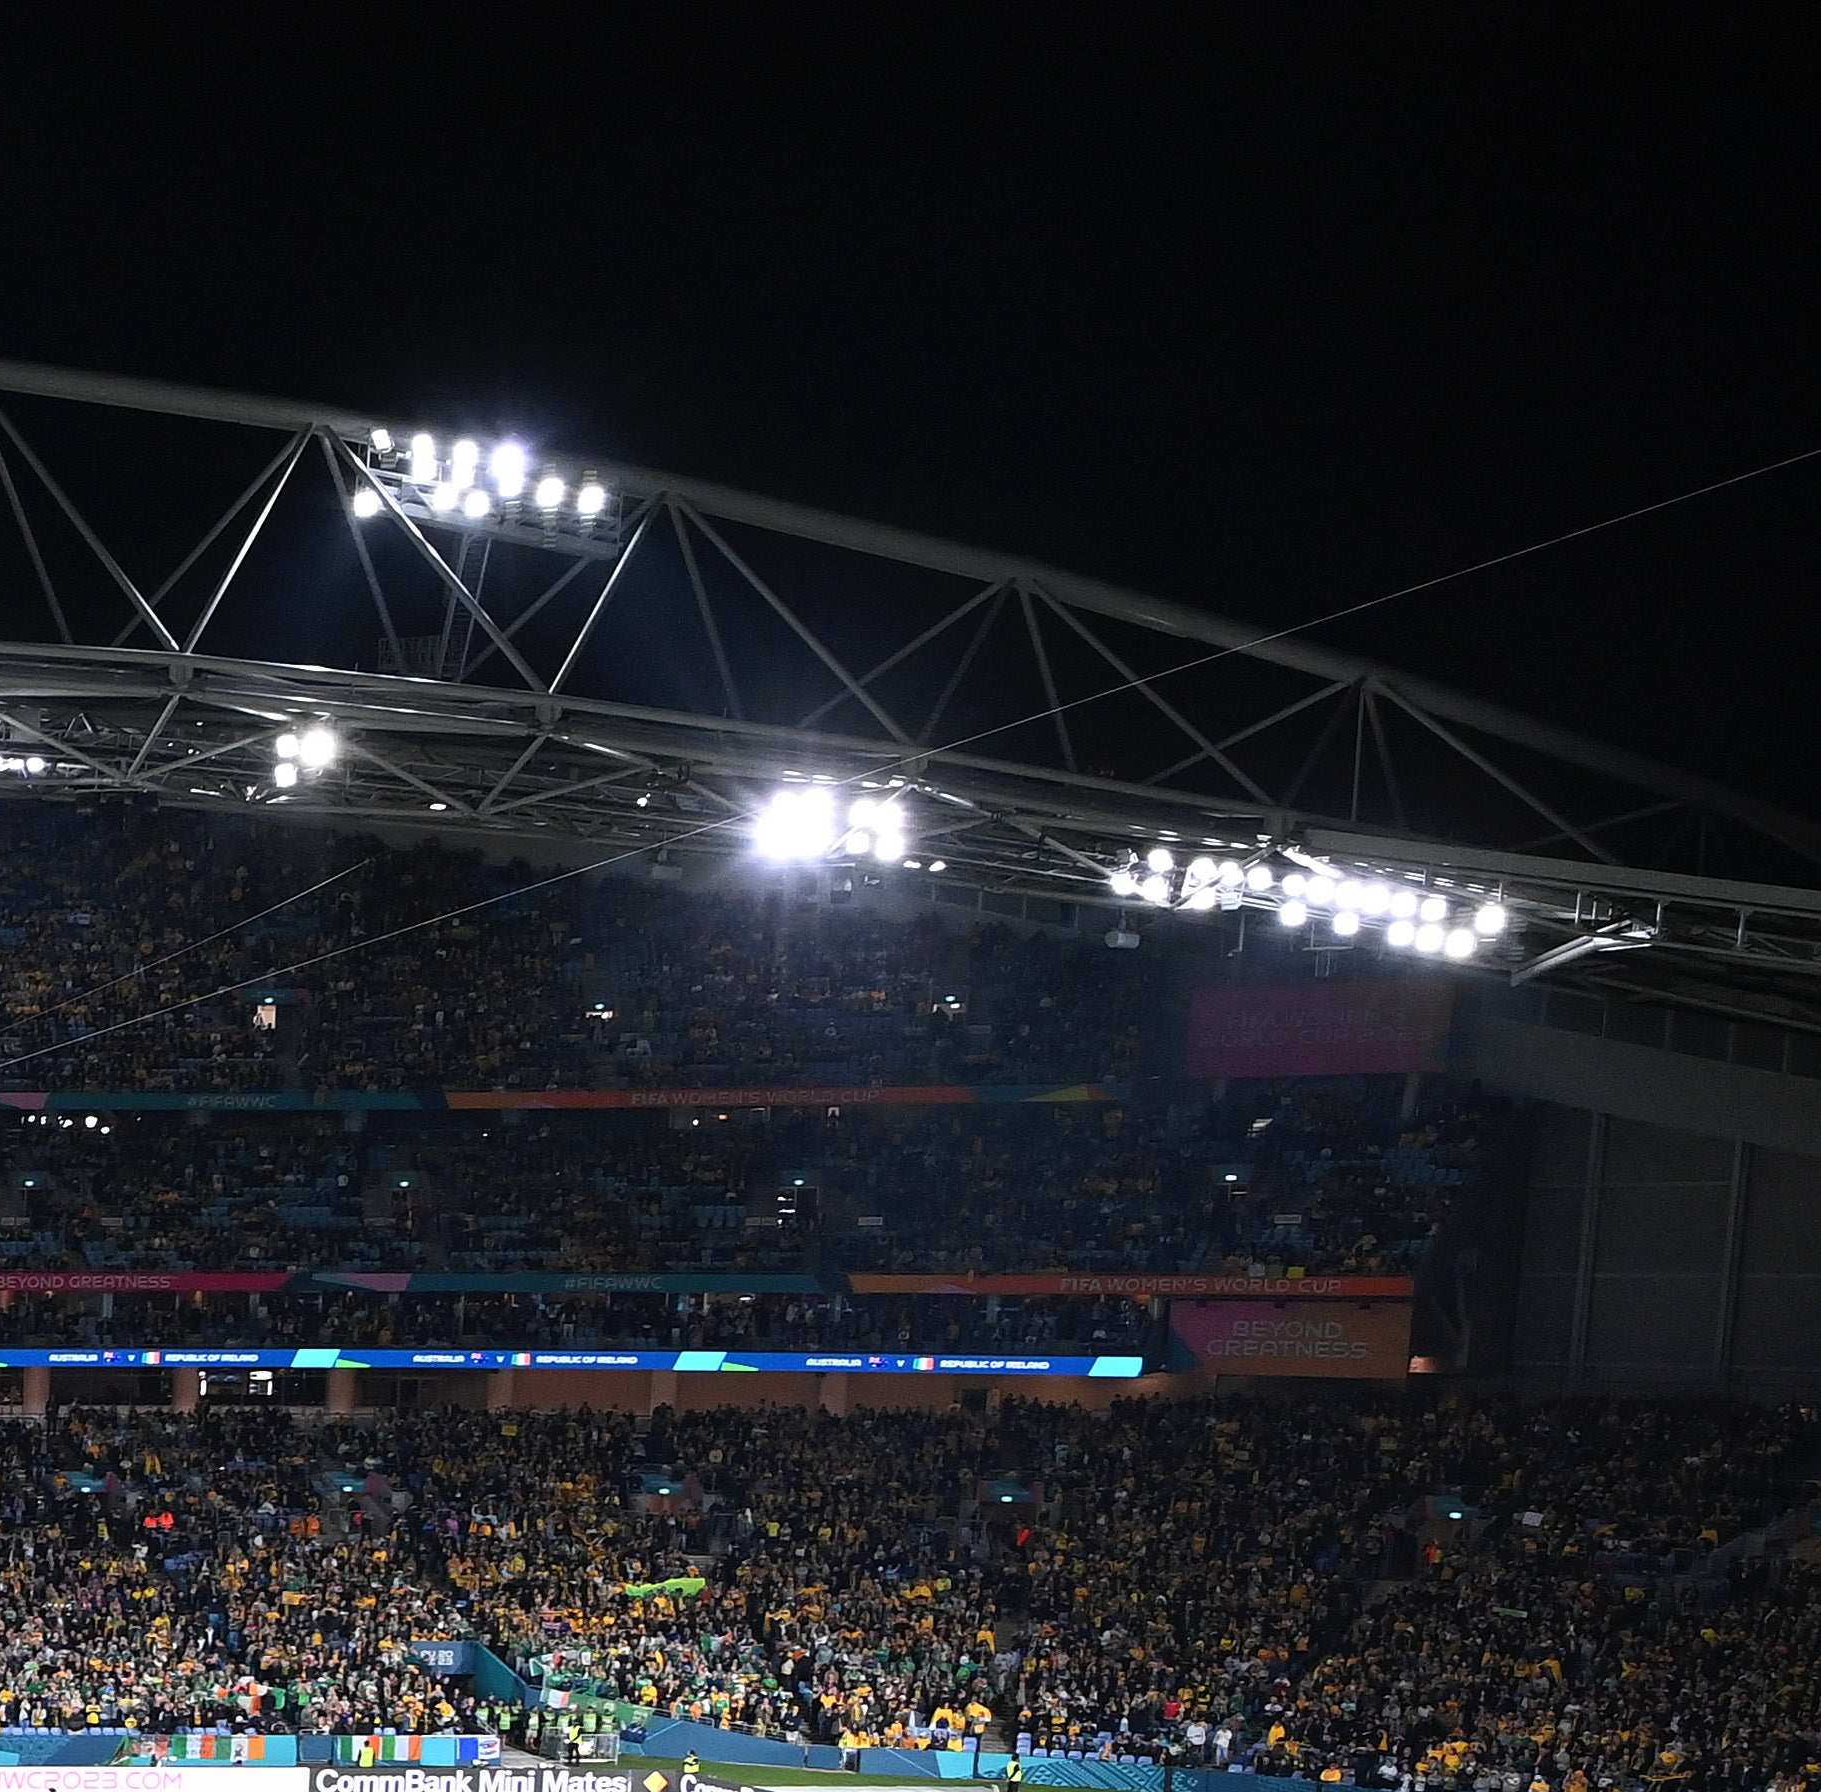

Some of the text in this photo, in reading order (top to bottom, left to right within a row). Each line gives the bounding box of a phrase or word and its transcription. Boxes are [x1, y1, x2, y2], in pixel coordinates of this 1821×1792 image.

[1060, 1277, 1343, 1293] FIFA WOMEN'S WORLD CUP
[1232, 1319, 1343, 1338] BEYOND
[1206, 1338, 1370, 1359] GREATNESS
[48, 1354, 99, 1362] AUSTRALIA
[164, 1354, 207, 1362] REPUBLIC
[222, 1354, 260, 1362] IRELAND
[412, 1355, 465, 1363] AUSTRALIA
[535, 1356, 582, 1364] REPUBLIC
[597, 1356, 638, 1364] IRELAND
[805, 1358, 862, 1367] AUSTRALIA
[939, 1360, 989, 1369] REPUBLIC
[1006, 1360, 1050, 1369] IRELAND
